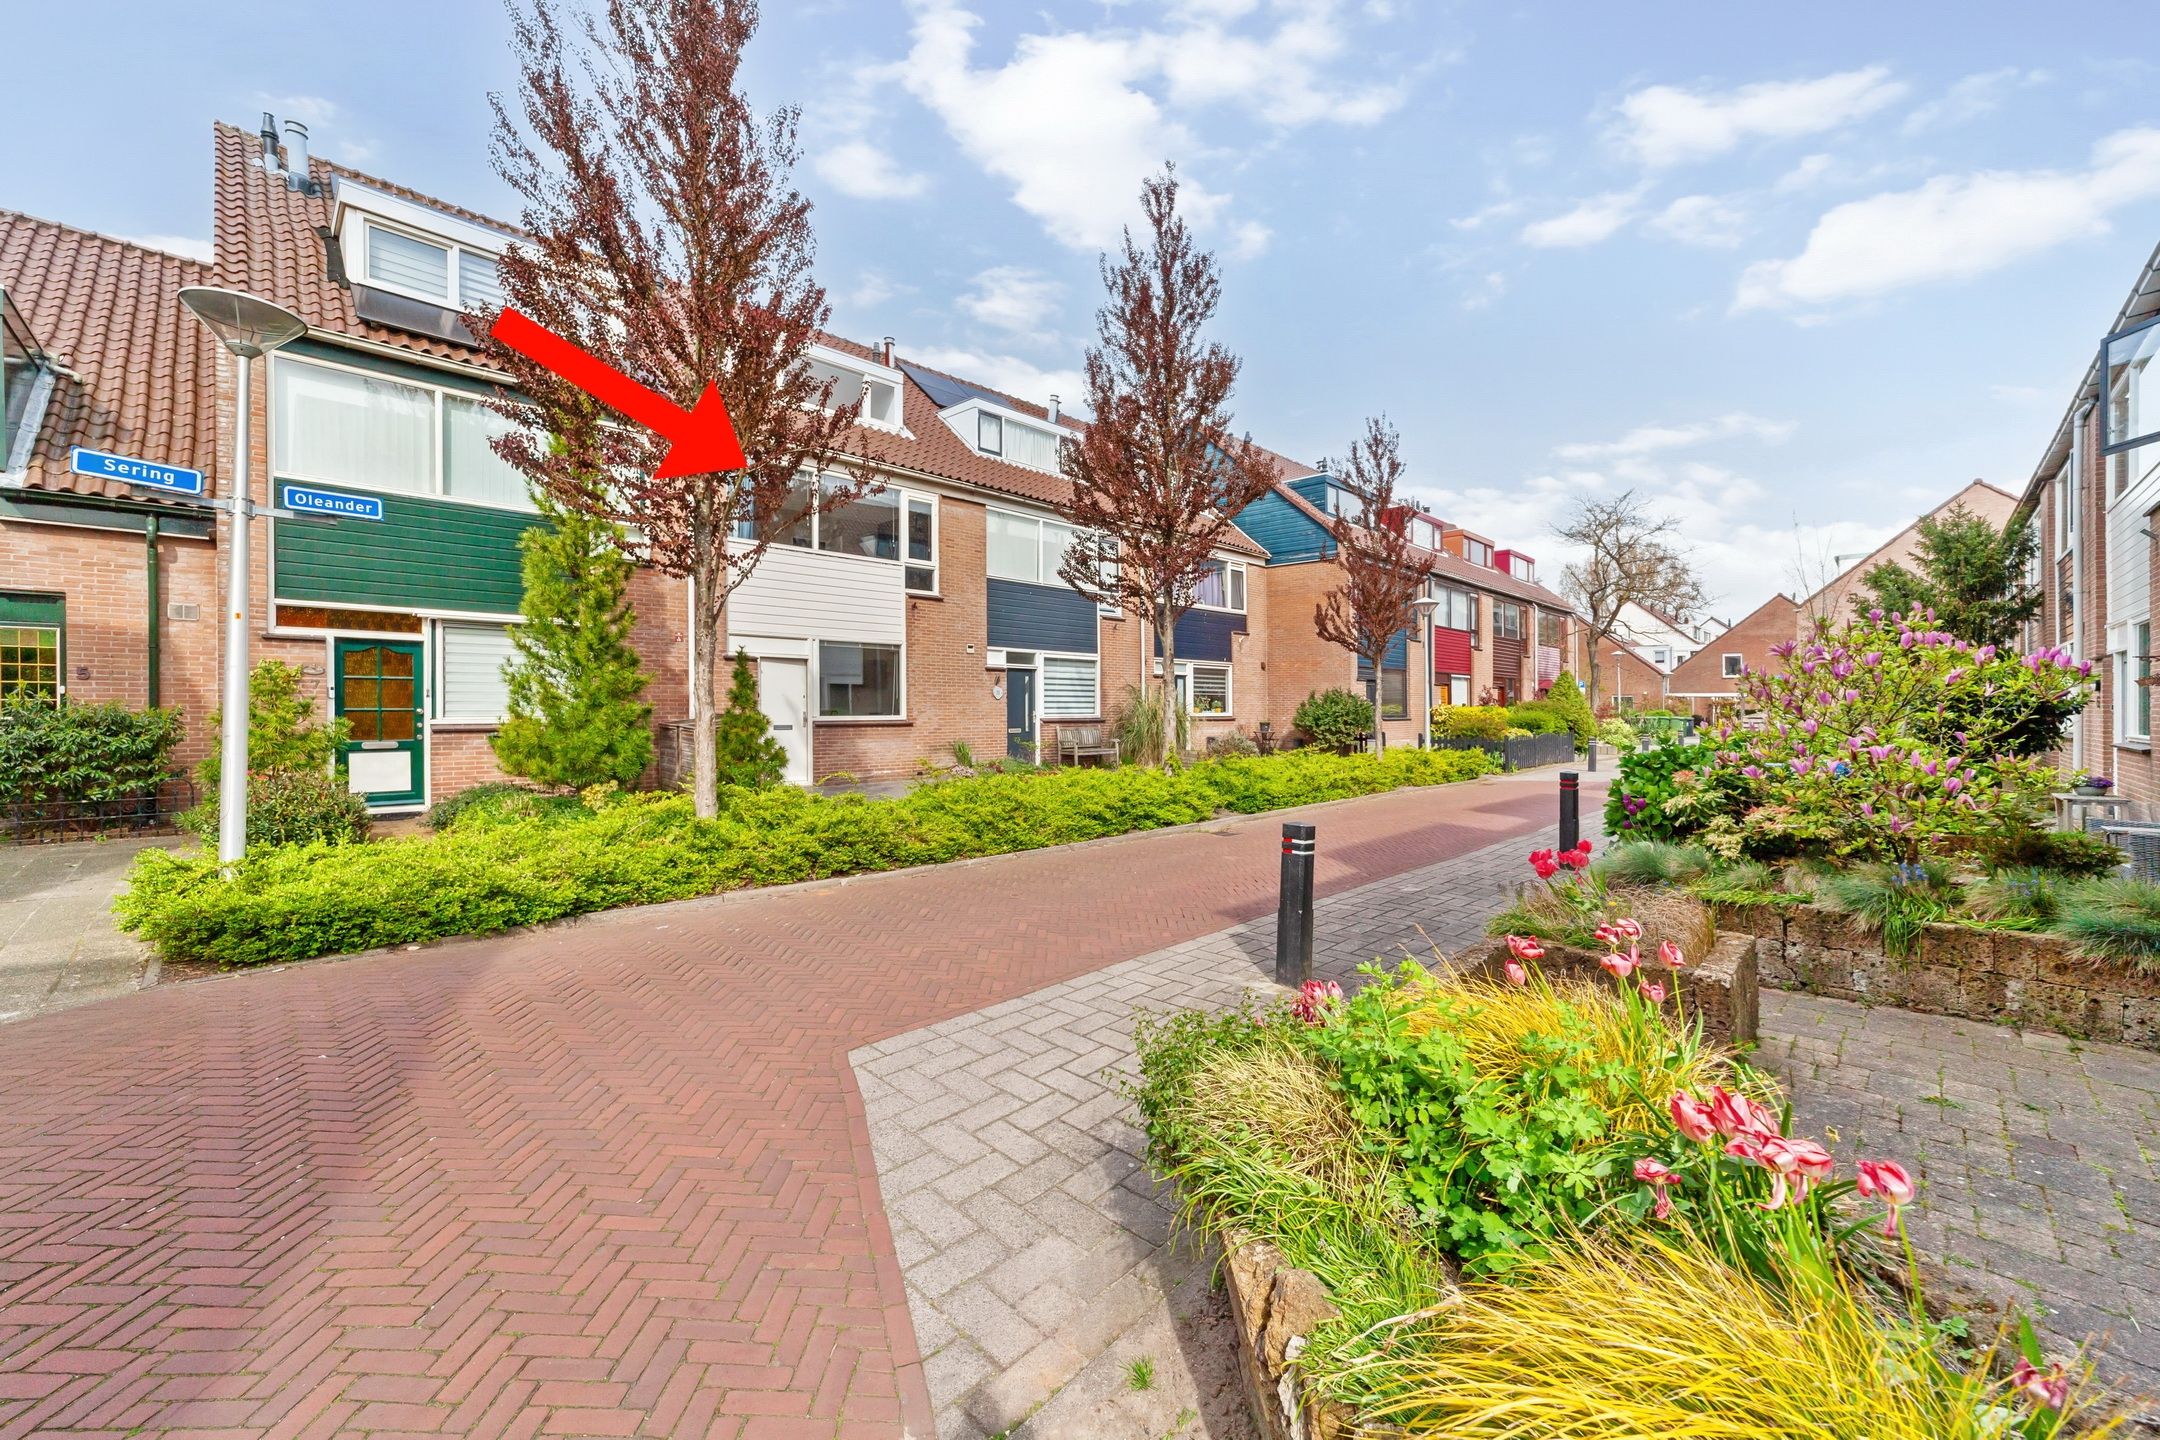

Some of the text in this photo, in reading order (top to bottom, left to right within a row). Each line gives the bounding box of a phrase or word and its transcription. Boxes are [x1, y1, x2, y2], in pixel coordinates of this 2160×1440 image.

[104, 459, 175, 485] Sering
[295, 493, 372, 513] Oleander
[77, 667, 91, 680] 5
